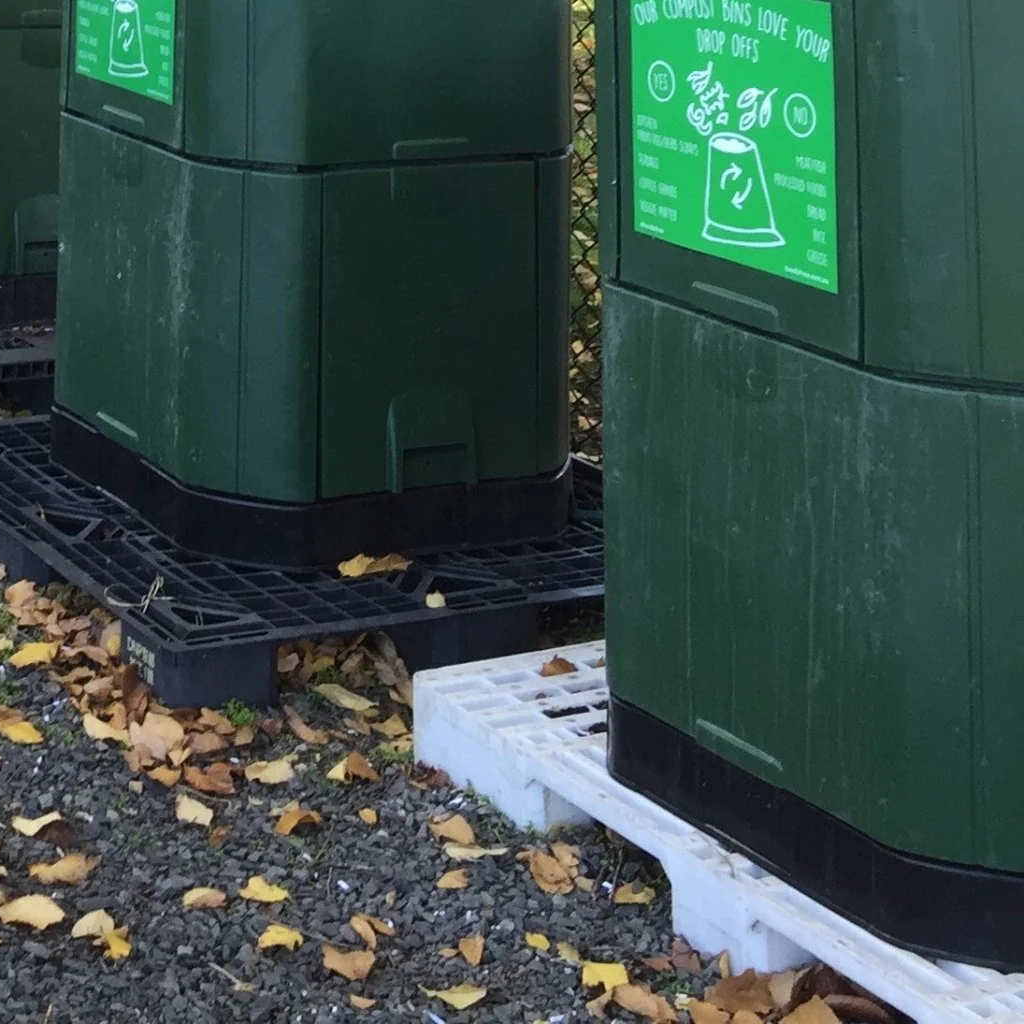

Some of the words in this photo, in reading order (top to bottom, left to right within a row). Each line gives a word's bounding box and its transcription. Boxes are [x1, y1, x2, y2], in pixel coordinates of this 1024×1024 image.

[634, 0, 658, 26] OUR
[757, 7, 789, 41] LOVE
[795, 25, 831, 63] YOUR
[696, 28, 725, 55] DROP
[731, 33, 760, 63] OFFS
[653, 72, 668, 92] YES
[793, 106, 808, 126] NO
